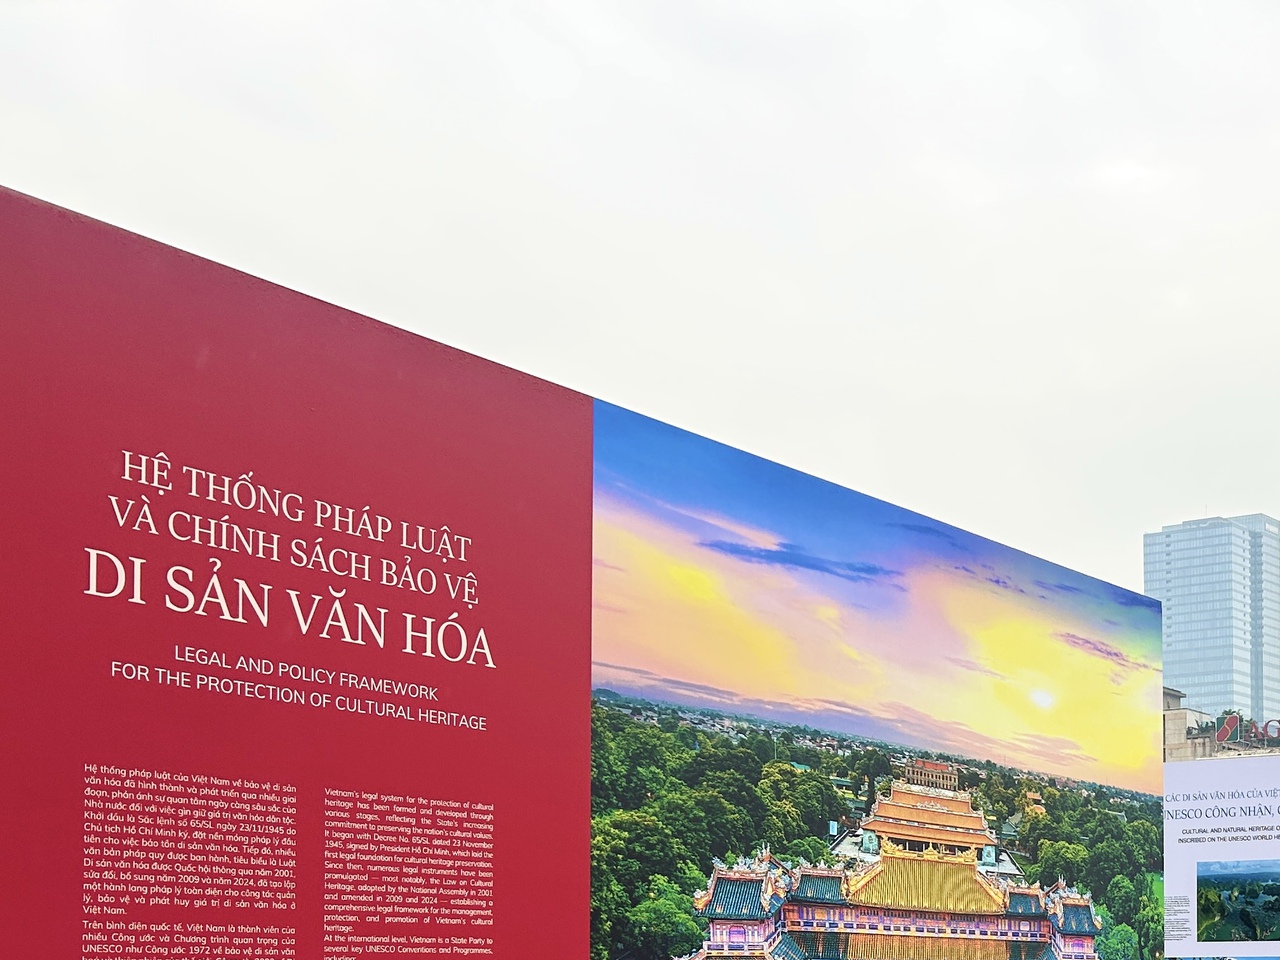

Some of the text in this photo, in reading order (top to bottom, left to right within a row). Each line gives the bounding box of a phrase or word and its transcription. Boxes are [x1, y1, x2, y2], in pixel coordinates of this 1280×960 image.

[108, 495, 478, 609] VÀ CHÍNH SÁCH BẢO VỆ
[121, 450, 471, 563] HỆ THỐNG PHÁP LUẬT
[84, 547, 496, 668] DI SẢN VĂN HÓA
[112, 661, 486, 730] FOR THE PROTECTION OF CULTURAL HERITAGE
[175, 645, 438, 701] LEGAL AND POLICY FRAMEWORK
[1205, 805, 1236, 818] CÔNG
